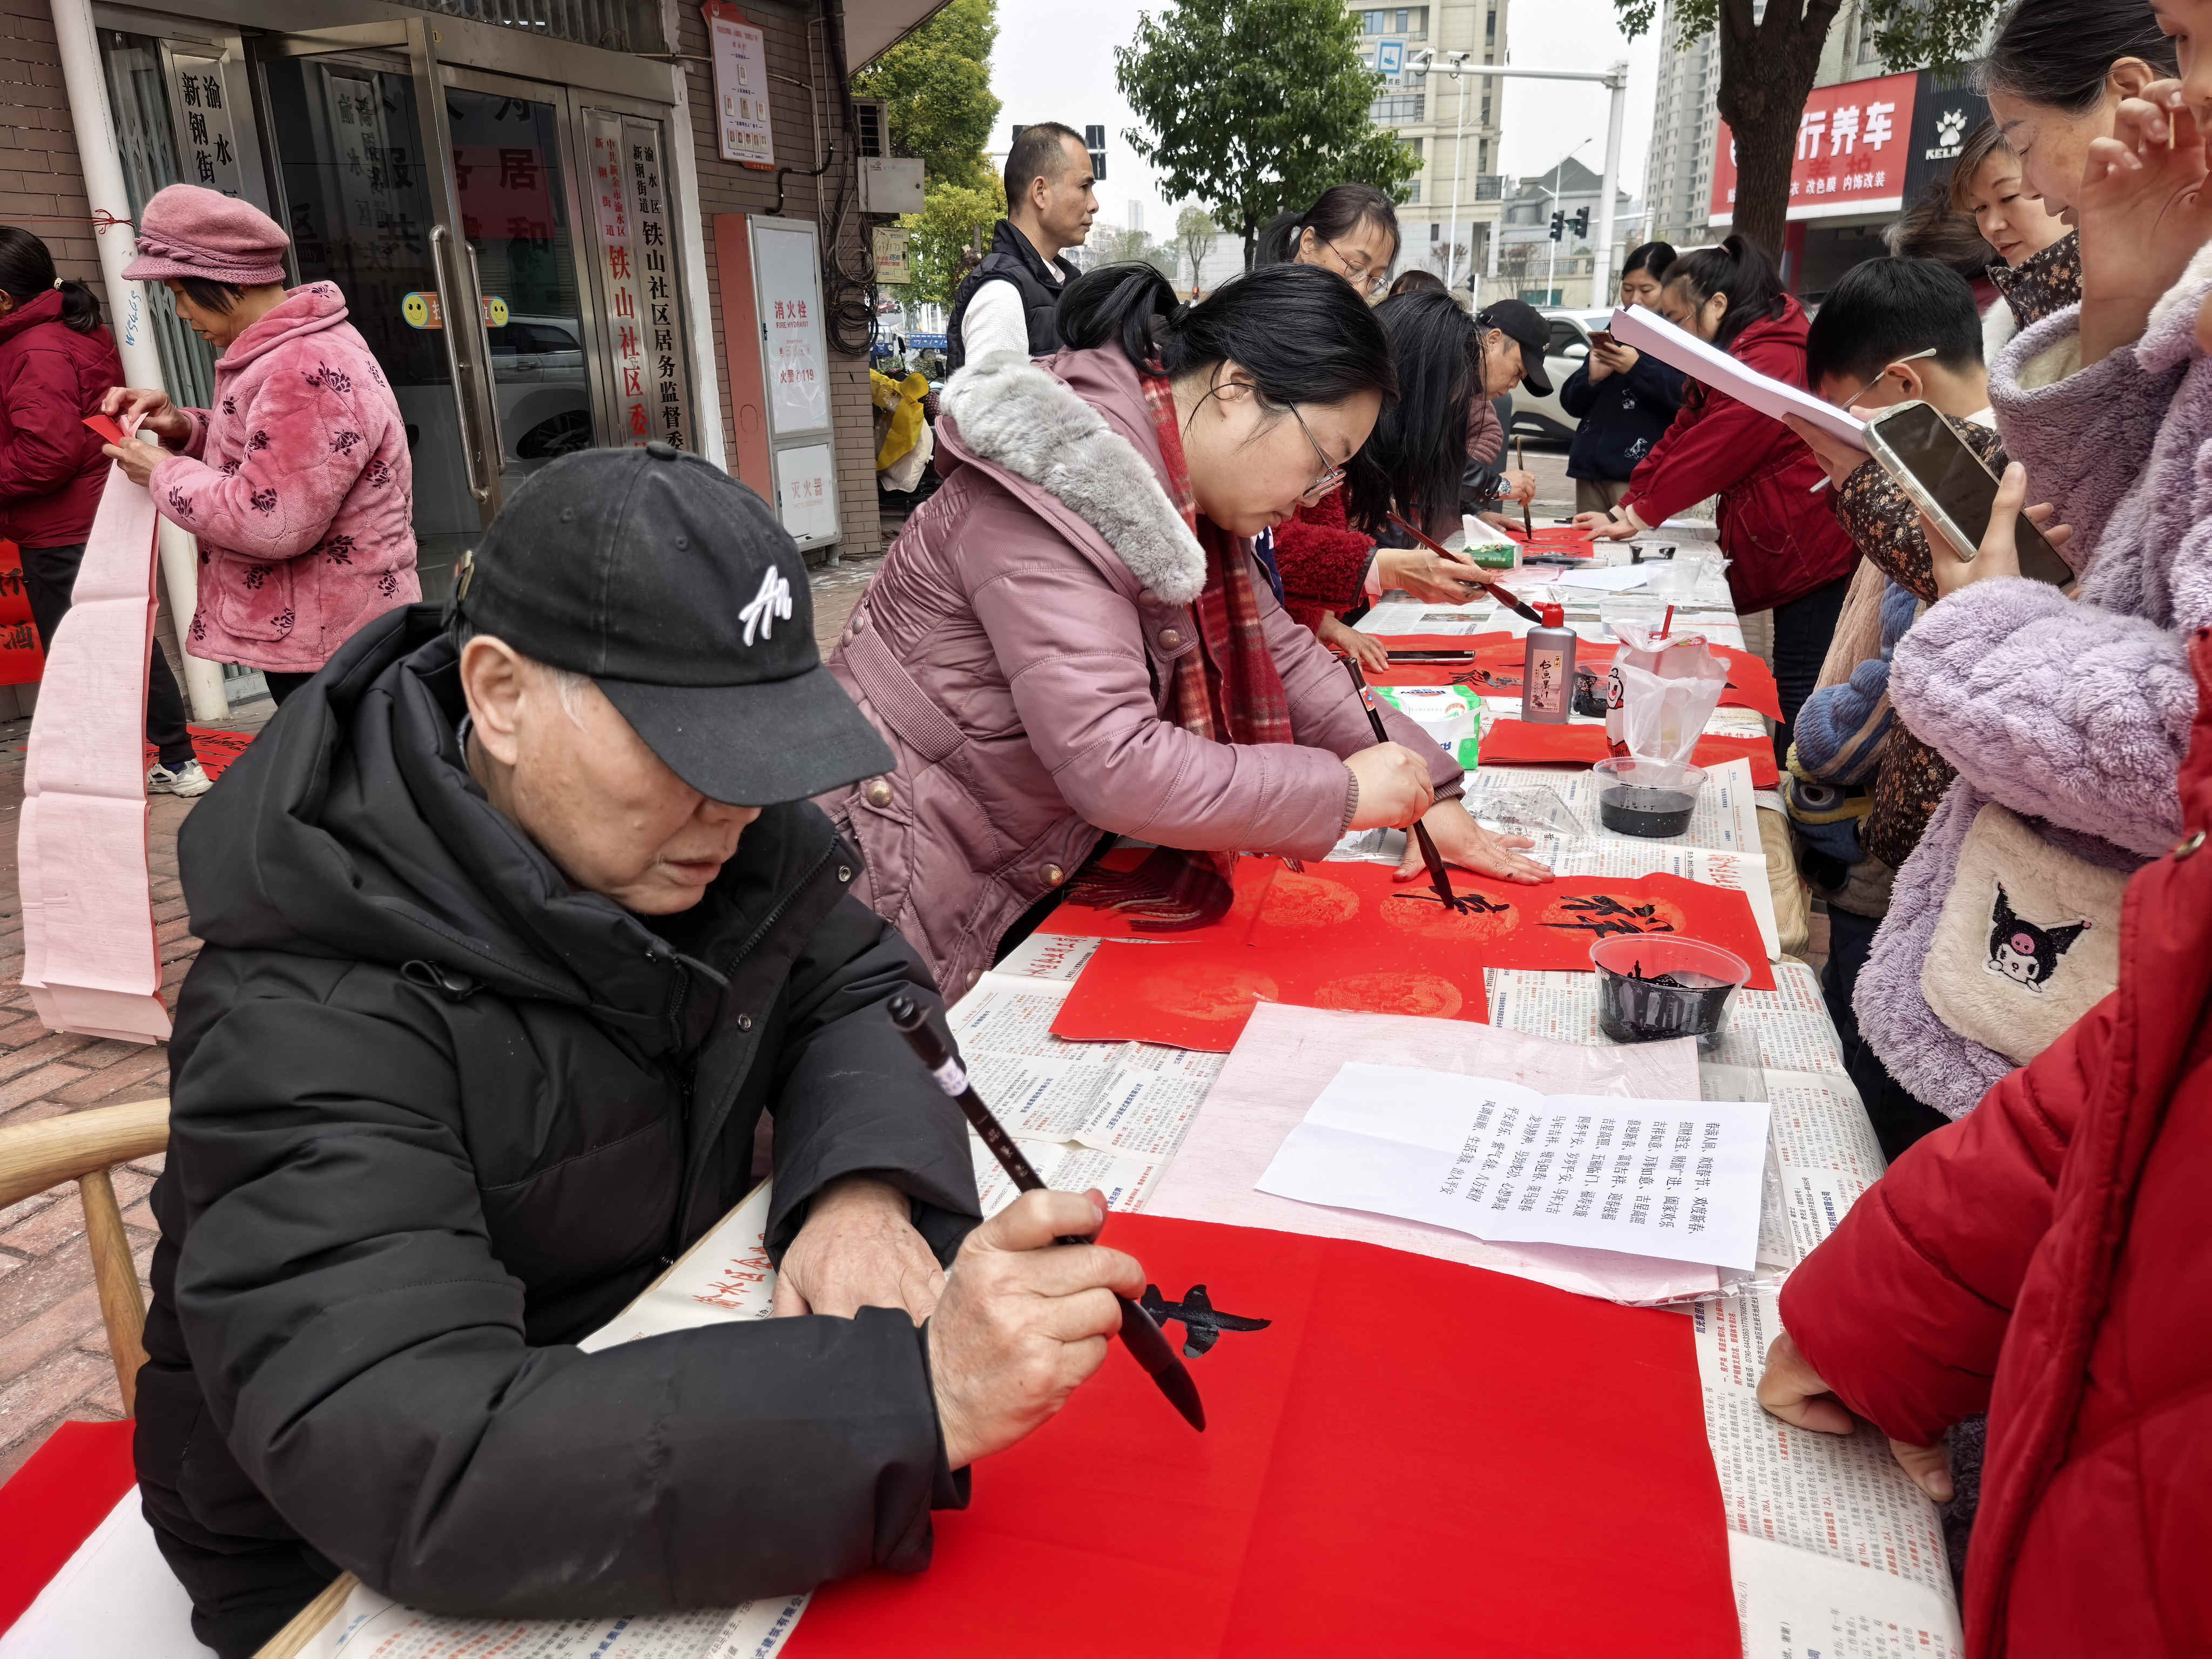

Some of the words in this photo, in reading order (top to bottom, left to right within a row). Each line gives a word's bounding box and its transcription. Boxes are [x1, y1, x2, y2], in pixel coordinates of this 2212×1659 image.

[181, 71, 215, 184] 新钢街
[1797, 102, 1895, 161] 行养车
[595, 137, 615, 237] 新钢街道
[606, 138, 627, 237] 中共新余市渝水区
[632, 144, 650, 214] 新钢街道
[643, 146, 662, 214] 渝水区
[1805, 177, 1836, 195] 改色膜
[1842, 170, 1886, 191] 内饰改装
[774, 299, 807, 320] 消火栓
[787, 321, 808, 329] HYDRANT
[609, 245, 648, 448] 铁山社区委
[780, 369, 795, 384] 火警
[802, 369, 814, 381] 119
[790, 477, 822, 498] 灭火器
[1539, 659, 1552, 699] 书画墨汁
